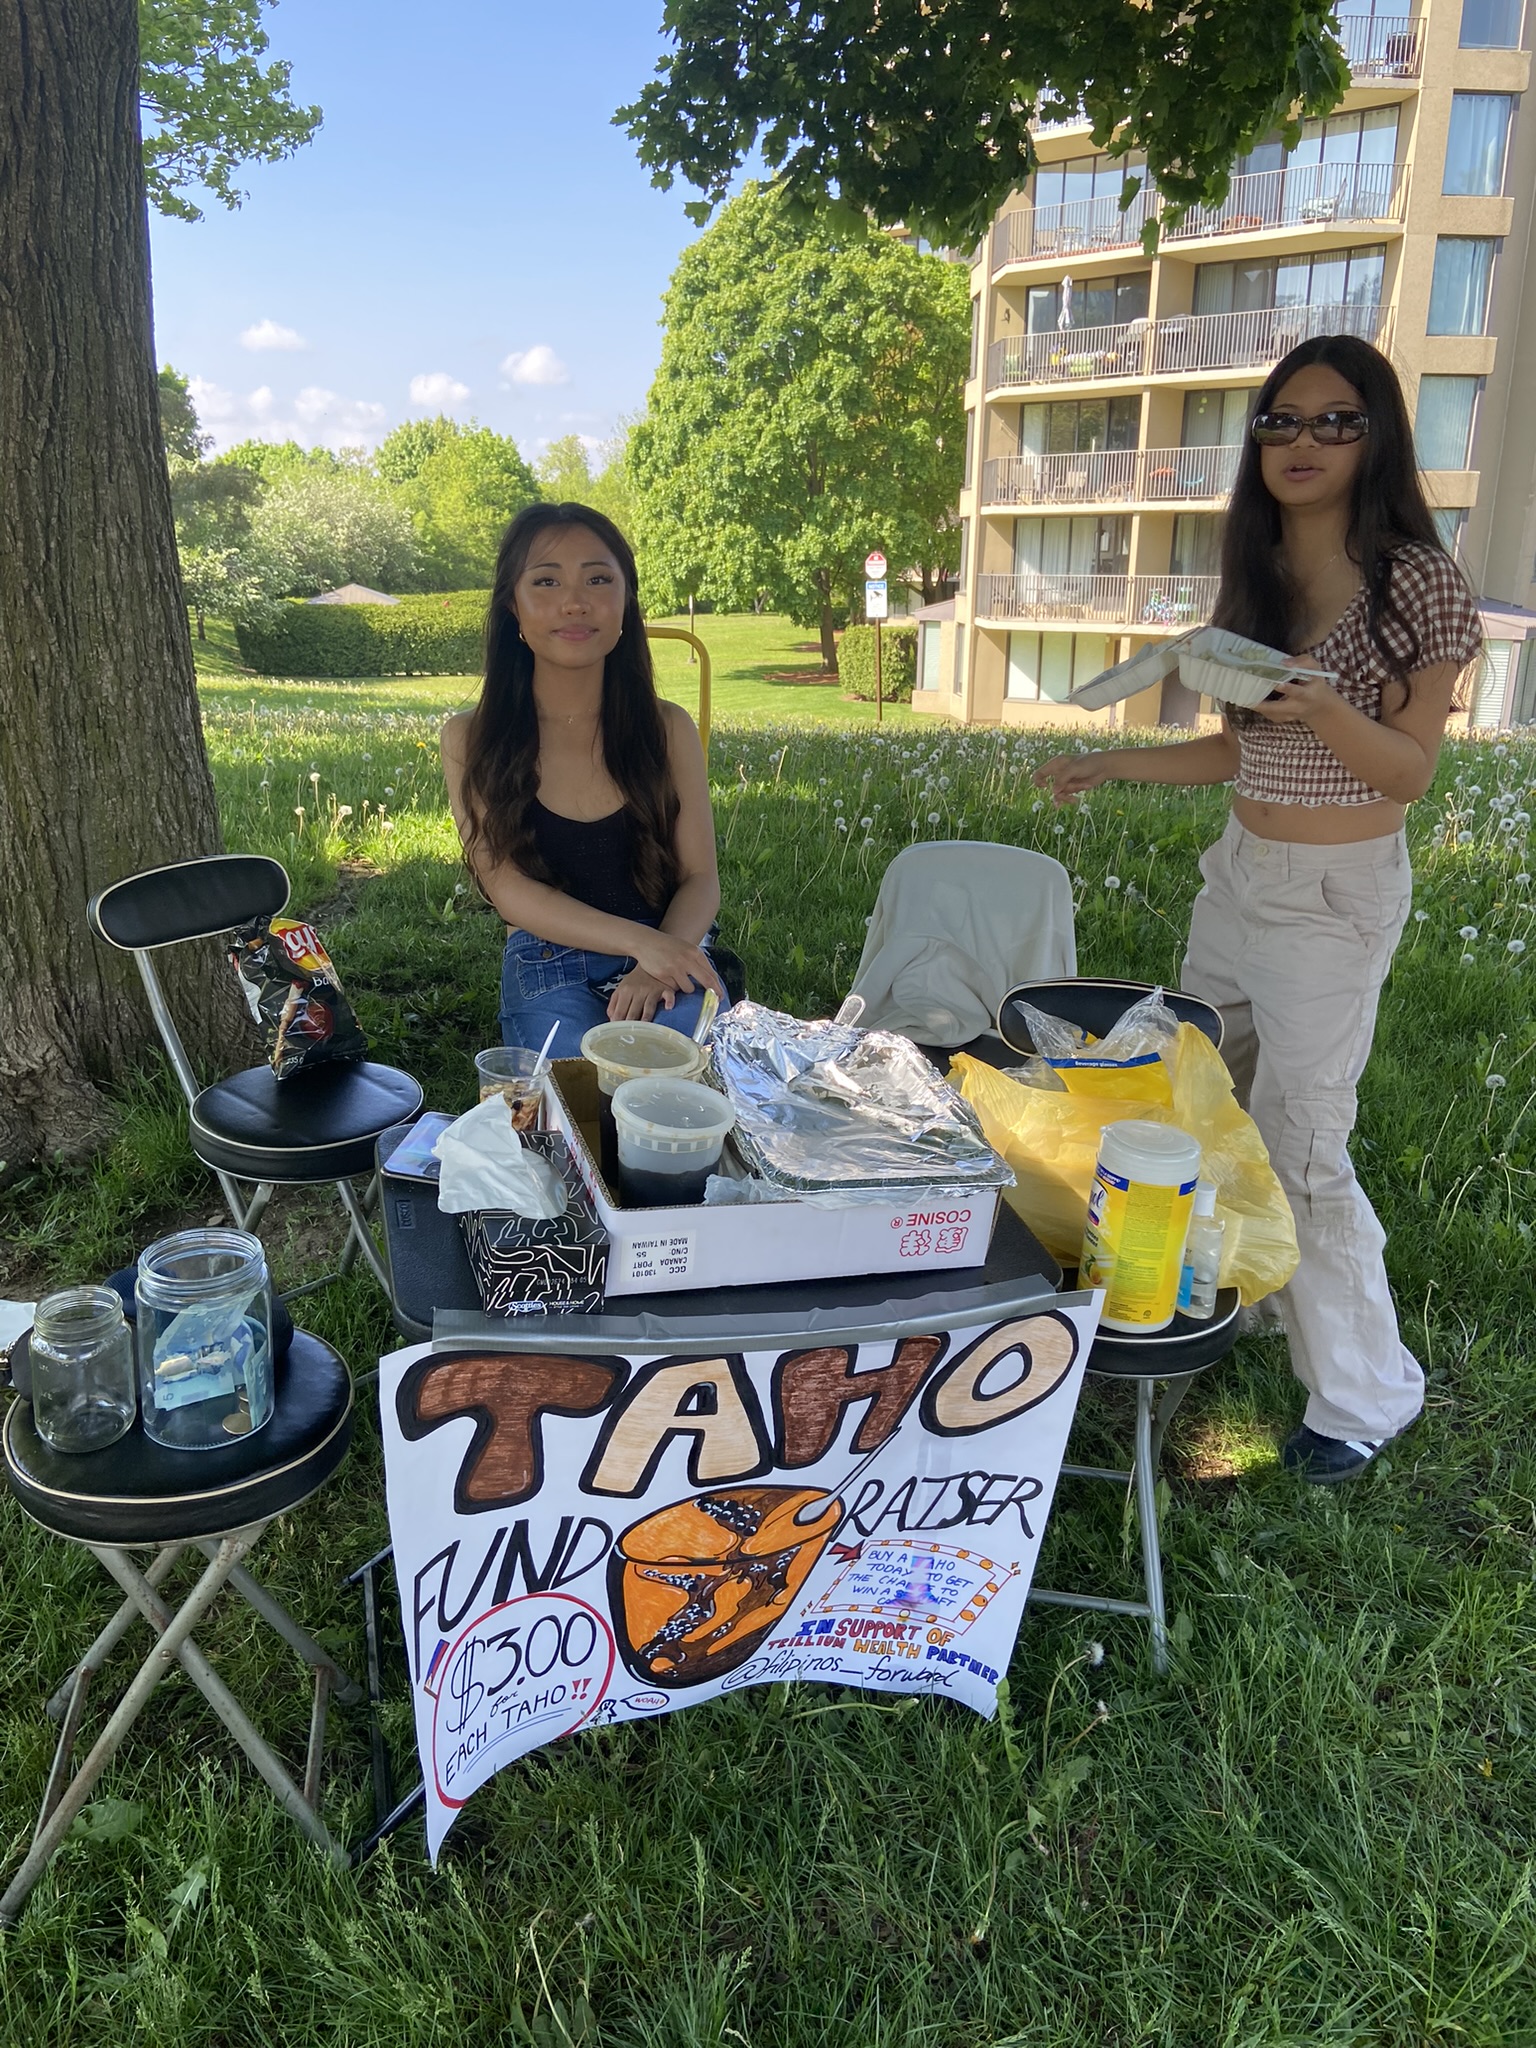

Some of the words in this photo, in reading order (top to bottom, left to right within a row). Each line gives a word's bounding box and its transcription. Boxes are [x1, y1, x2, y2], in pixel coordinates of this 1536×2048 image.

[906, 1209, 971, 1227] COSINE
[632, 1240, 658, 1249] TAIWAN
[660, 1239, 668, 1247] IN
[669, 1237, 688, 1246] MADE
[633, 1261, 653, 1269] PORT
[660, 1256, 688, 1266] CANADA
[669, 1265, 687, 1274] GCC
[632, 1269, 657, 1278] 130101
[396, 1308, 1079, 1515] TAHO
[867, 1550, 894, 1561] BUY
[899, 1553, 908, 1563] A
[413, 1516, 614, 1685] FUND
[829, 1470, 1044, 1543] RAISER
[867, 1563, 914, 1576] TODAY
[926, 1572, 943, 1582] TO
[945, 1577, 974, 1588] GET
[847, 1573, 873, 1583] THE
[941, 1586, 959, 1597] TO
[852, 1585, 879, 1596] WIN
[880, 1587, 891, 1596] A
[795, 1618, 836, 1637] IN
[835, 1617, 923, 1641] SUPPORT
[926, 1628, 955, 1647] OF
[767, 1635, 847, 1651] TRILLIUM
[852, 1638, 923, 1660] HEALTH
[925, 1645, 999, 1686] PARTNER
[446, 1611, 597, 1735] $3.00
[490, 1690, 519, 1718] for
[445, 1722, 488, 1787] EACH
